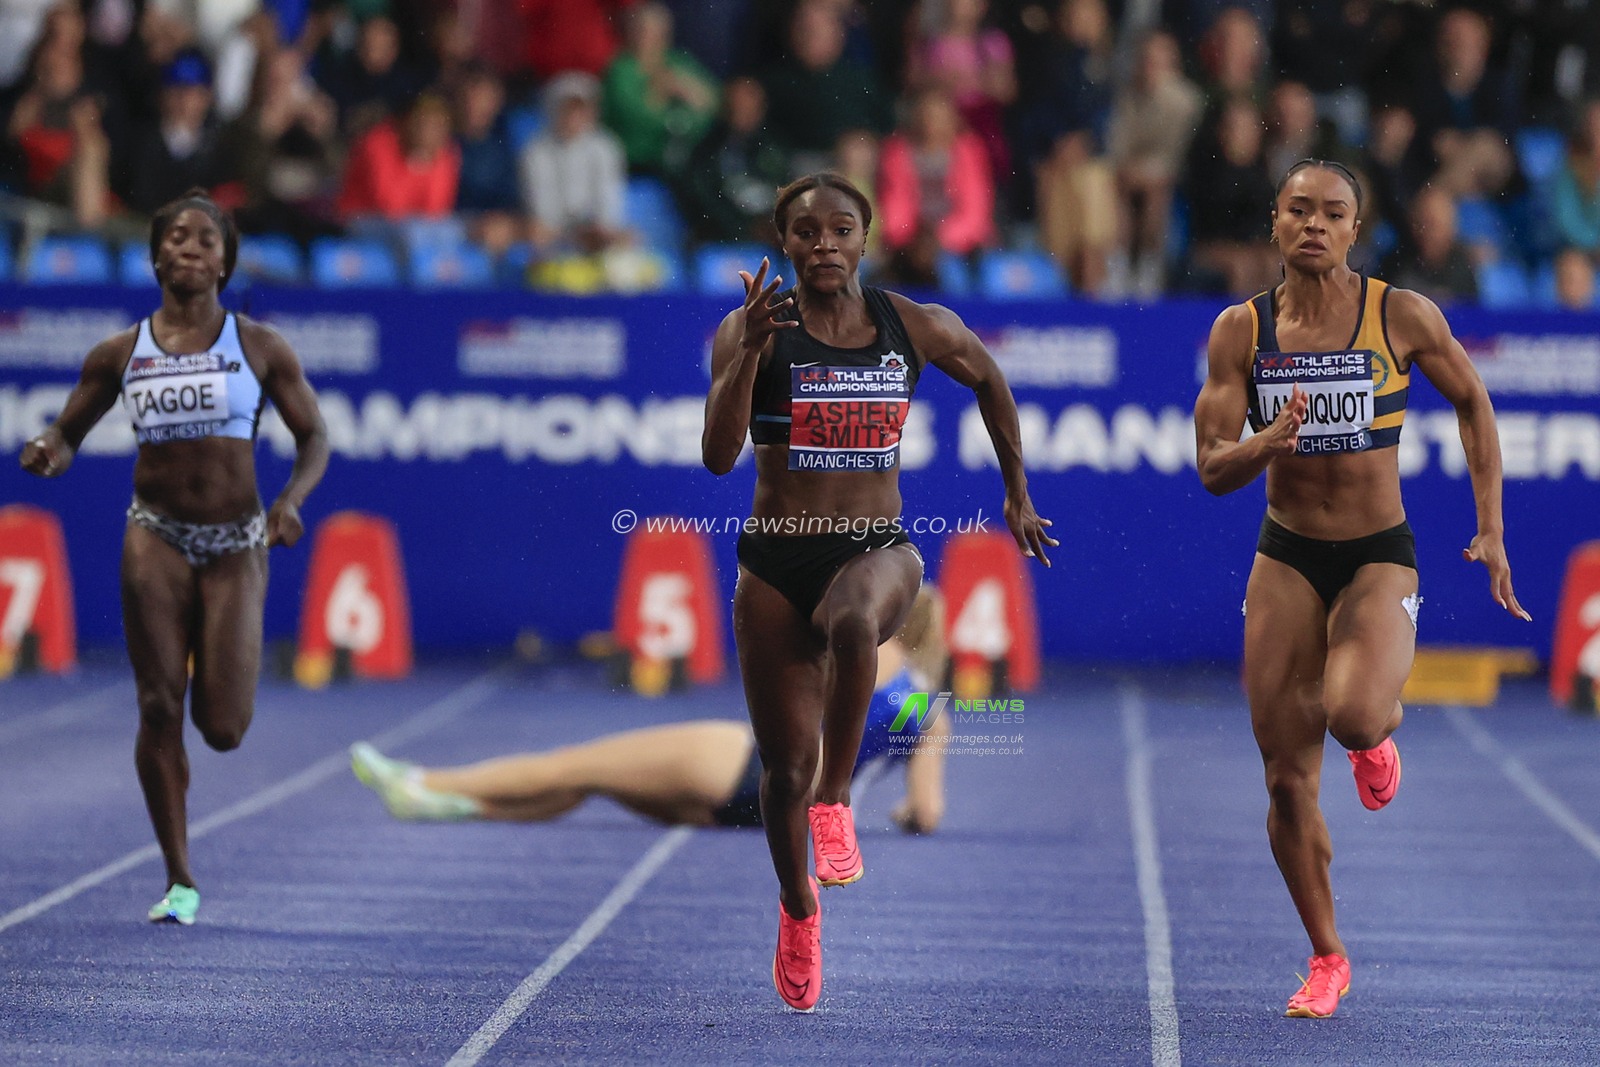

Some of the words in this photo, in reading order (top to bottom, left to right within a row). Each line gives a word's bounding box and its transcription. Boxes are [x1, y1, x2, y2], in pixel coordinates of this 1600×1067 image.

[1261, 365, 1366, 378] CHAMPIONSHIPS
[1281, 353, 1365, 369] ATHLETICS
[800, 383, 905, 392] CHAMPIONSHIPS
[825, 370, 905, 382] ATHLETICS
[131, 383, 215, 419] TAGOE
[1262, 391, 1368, 425] LAIQUOT
[805, 402, 900, 425] ASHER
[798, 451, 895, 469] MANCHESTER
[325, 563, 385, 654] 6
[639, 572, 697, 659] 5
[951, 578, 1012, 661] 4
